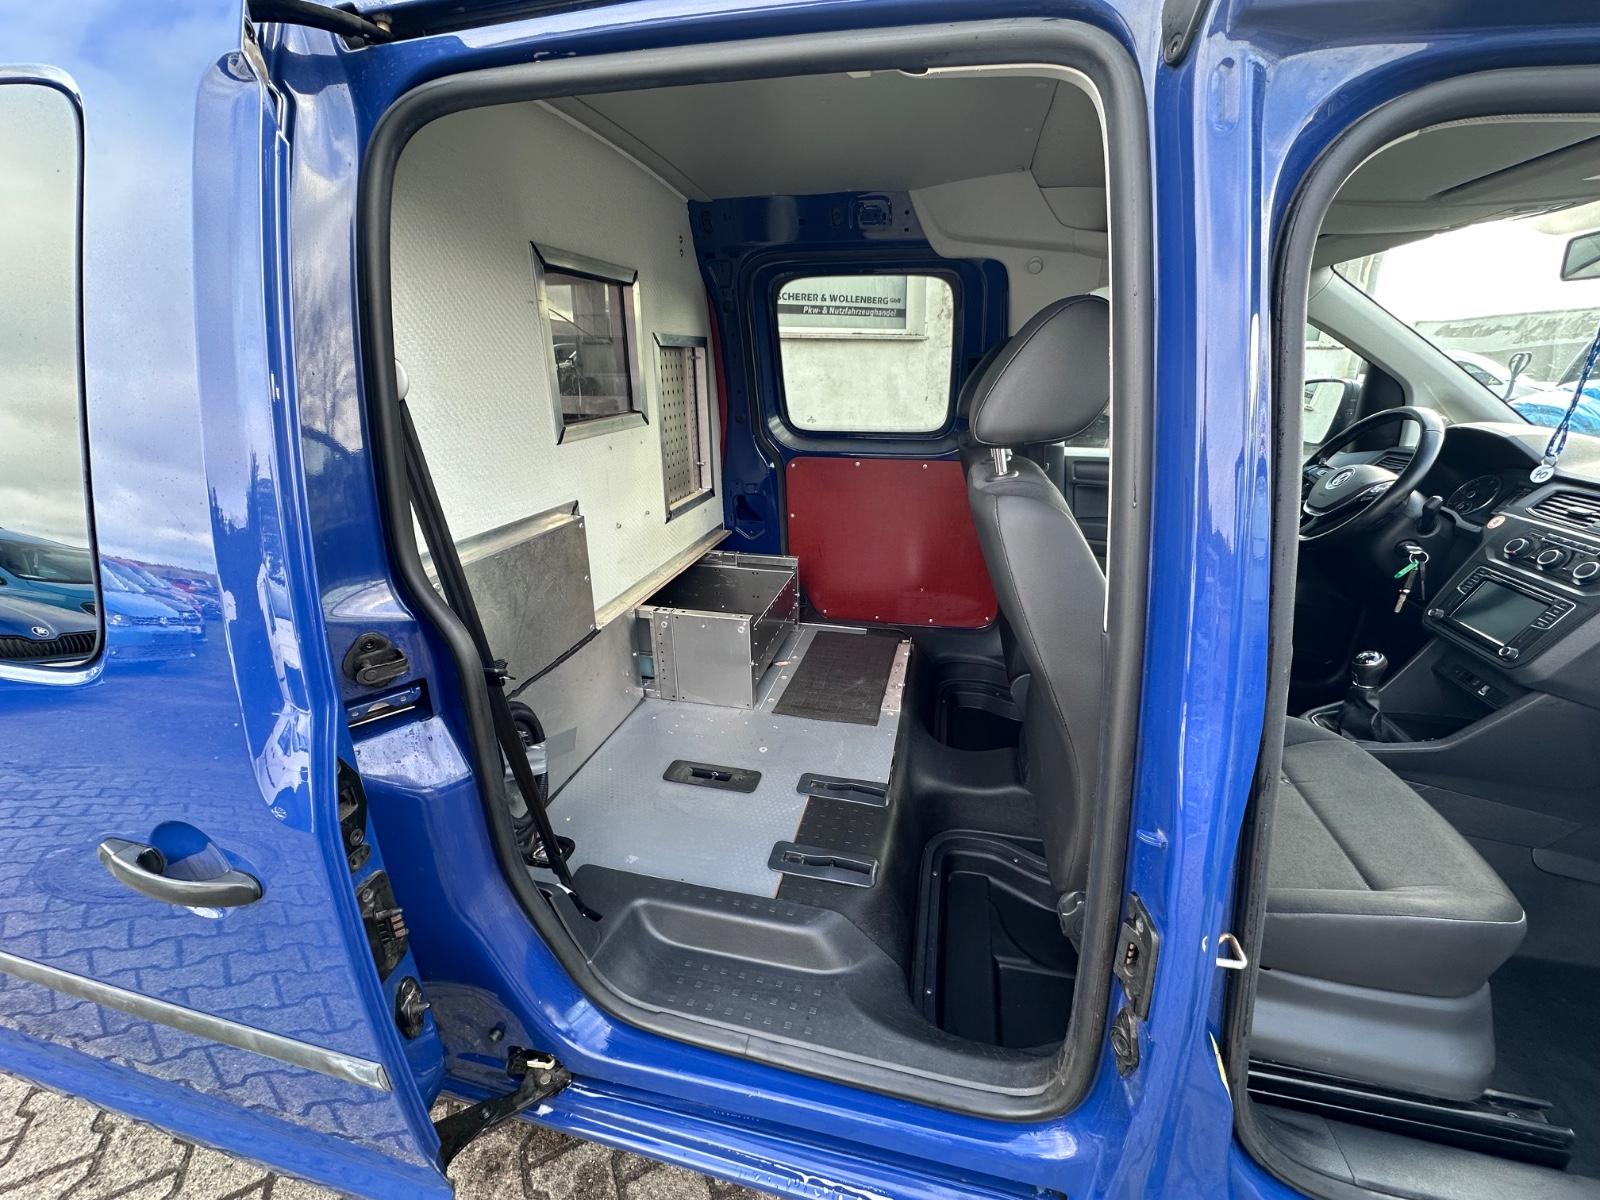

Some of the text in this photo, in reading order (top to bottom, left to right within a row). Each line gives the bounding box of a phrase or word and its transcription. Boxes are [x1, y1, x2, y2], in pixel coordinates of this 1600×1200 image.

[820, 294, 827, 302] &
[829, 294, 889, 305] WOLLENBERG
[803, 305, 897, 317] Pkw- & Nutzfahrzeughandel
